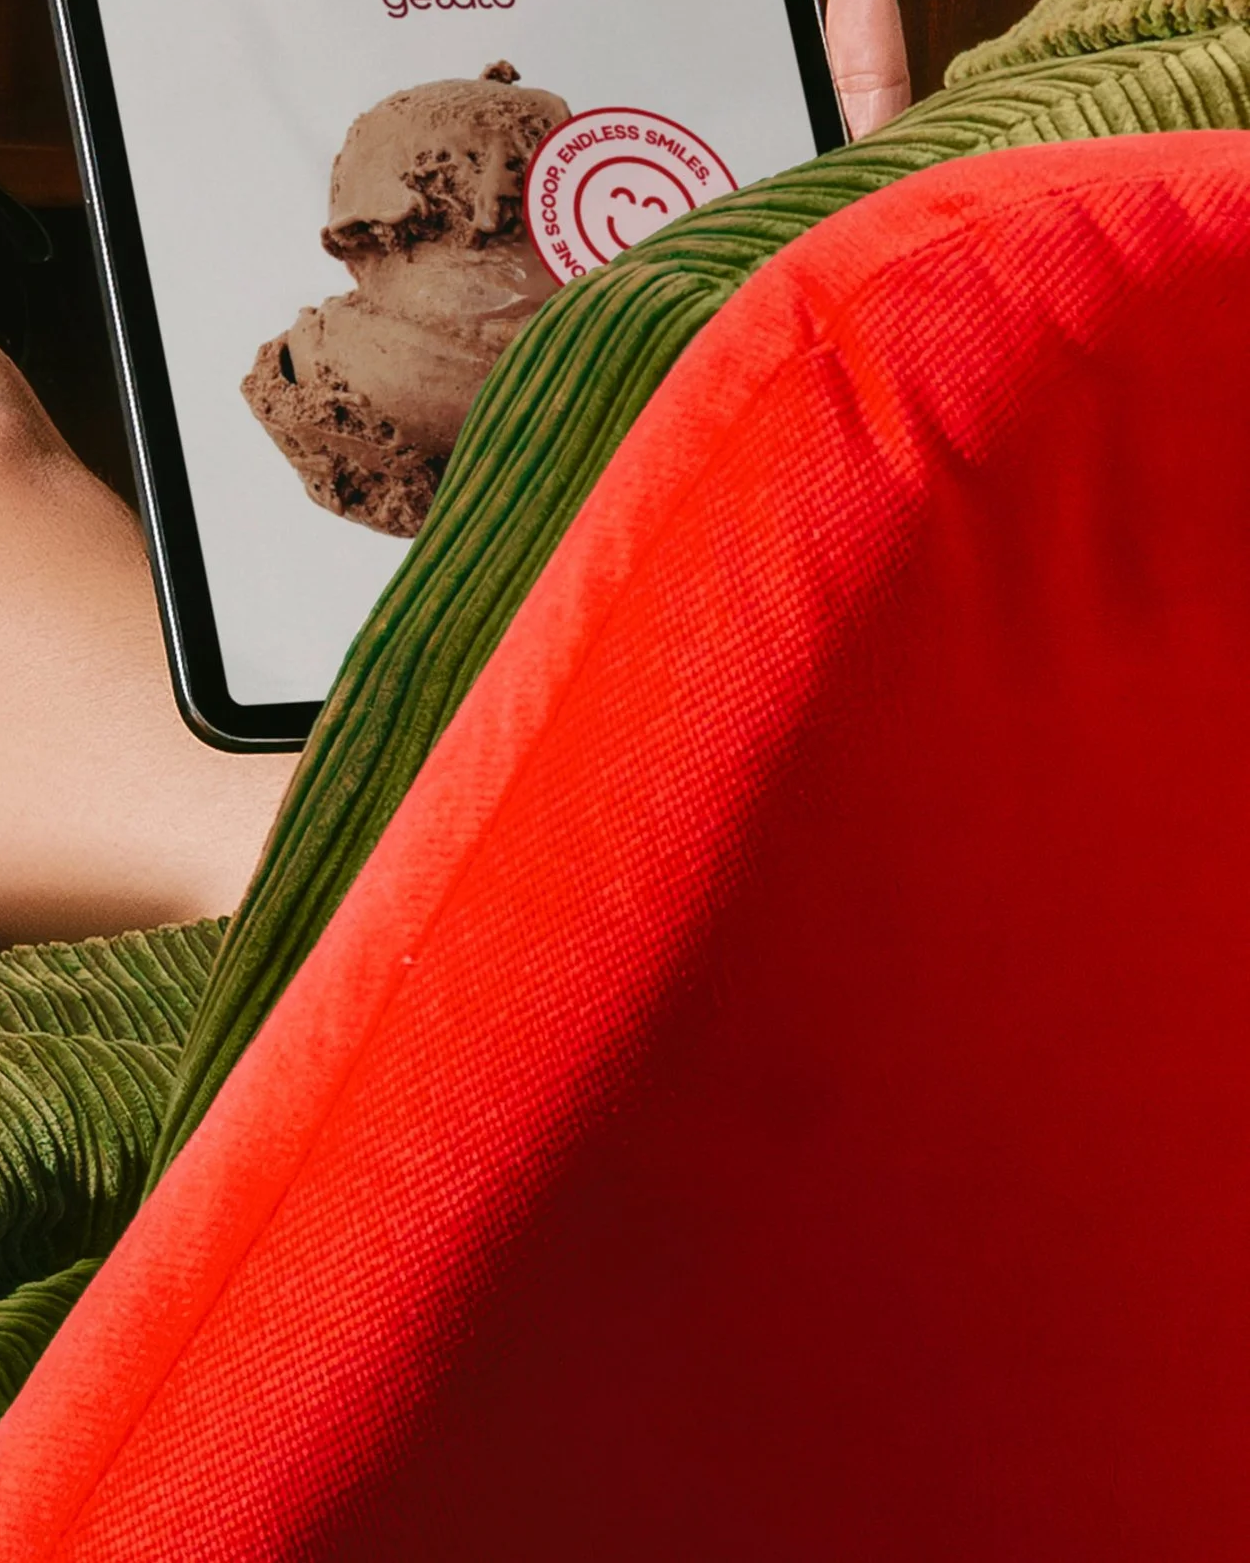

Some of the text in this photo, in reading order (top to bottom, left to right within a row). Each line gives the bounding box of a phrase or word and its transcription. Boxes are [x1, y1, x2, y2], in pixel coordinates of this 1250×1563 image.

[540, 124, 711, 279] ONE SCOOP, ENDLESS SMILES.
